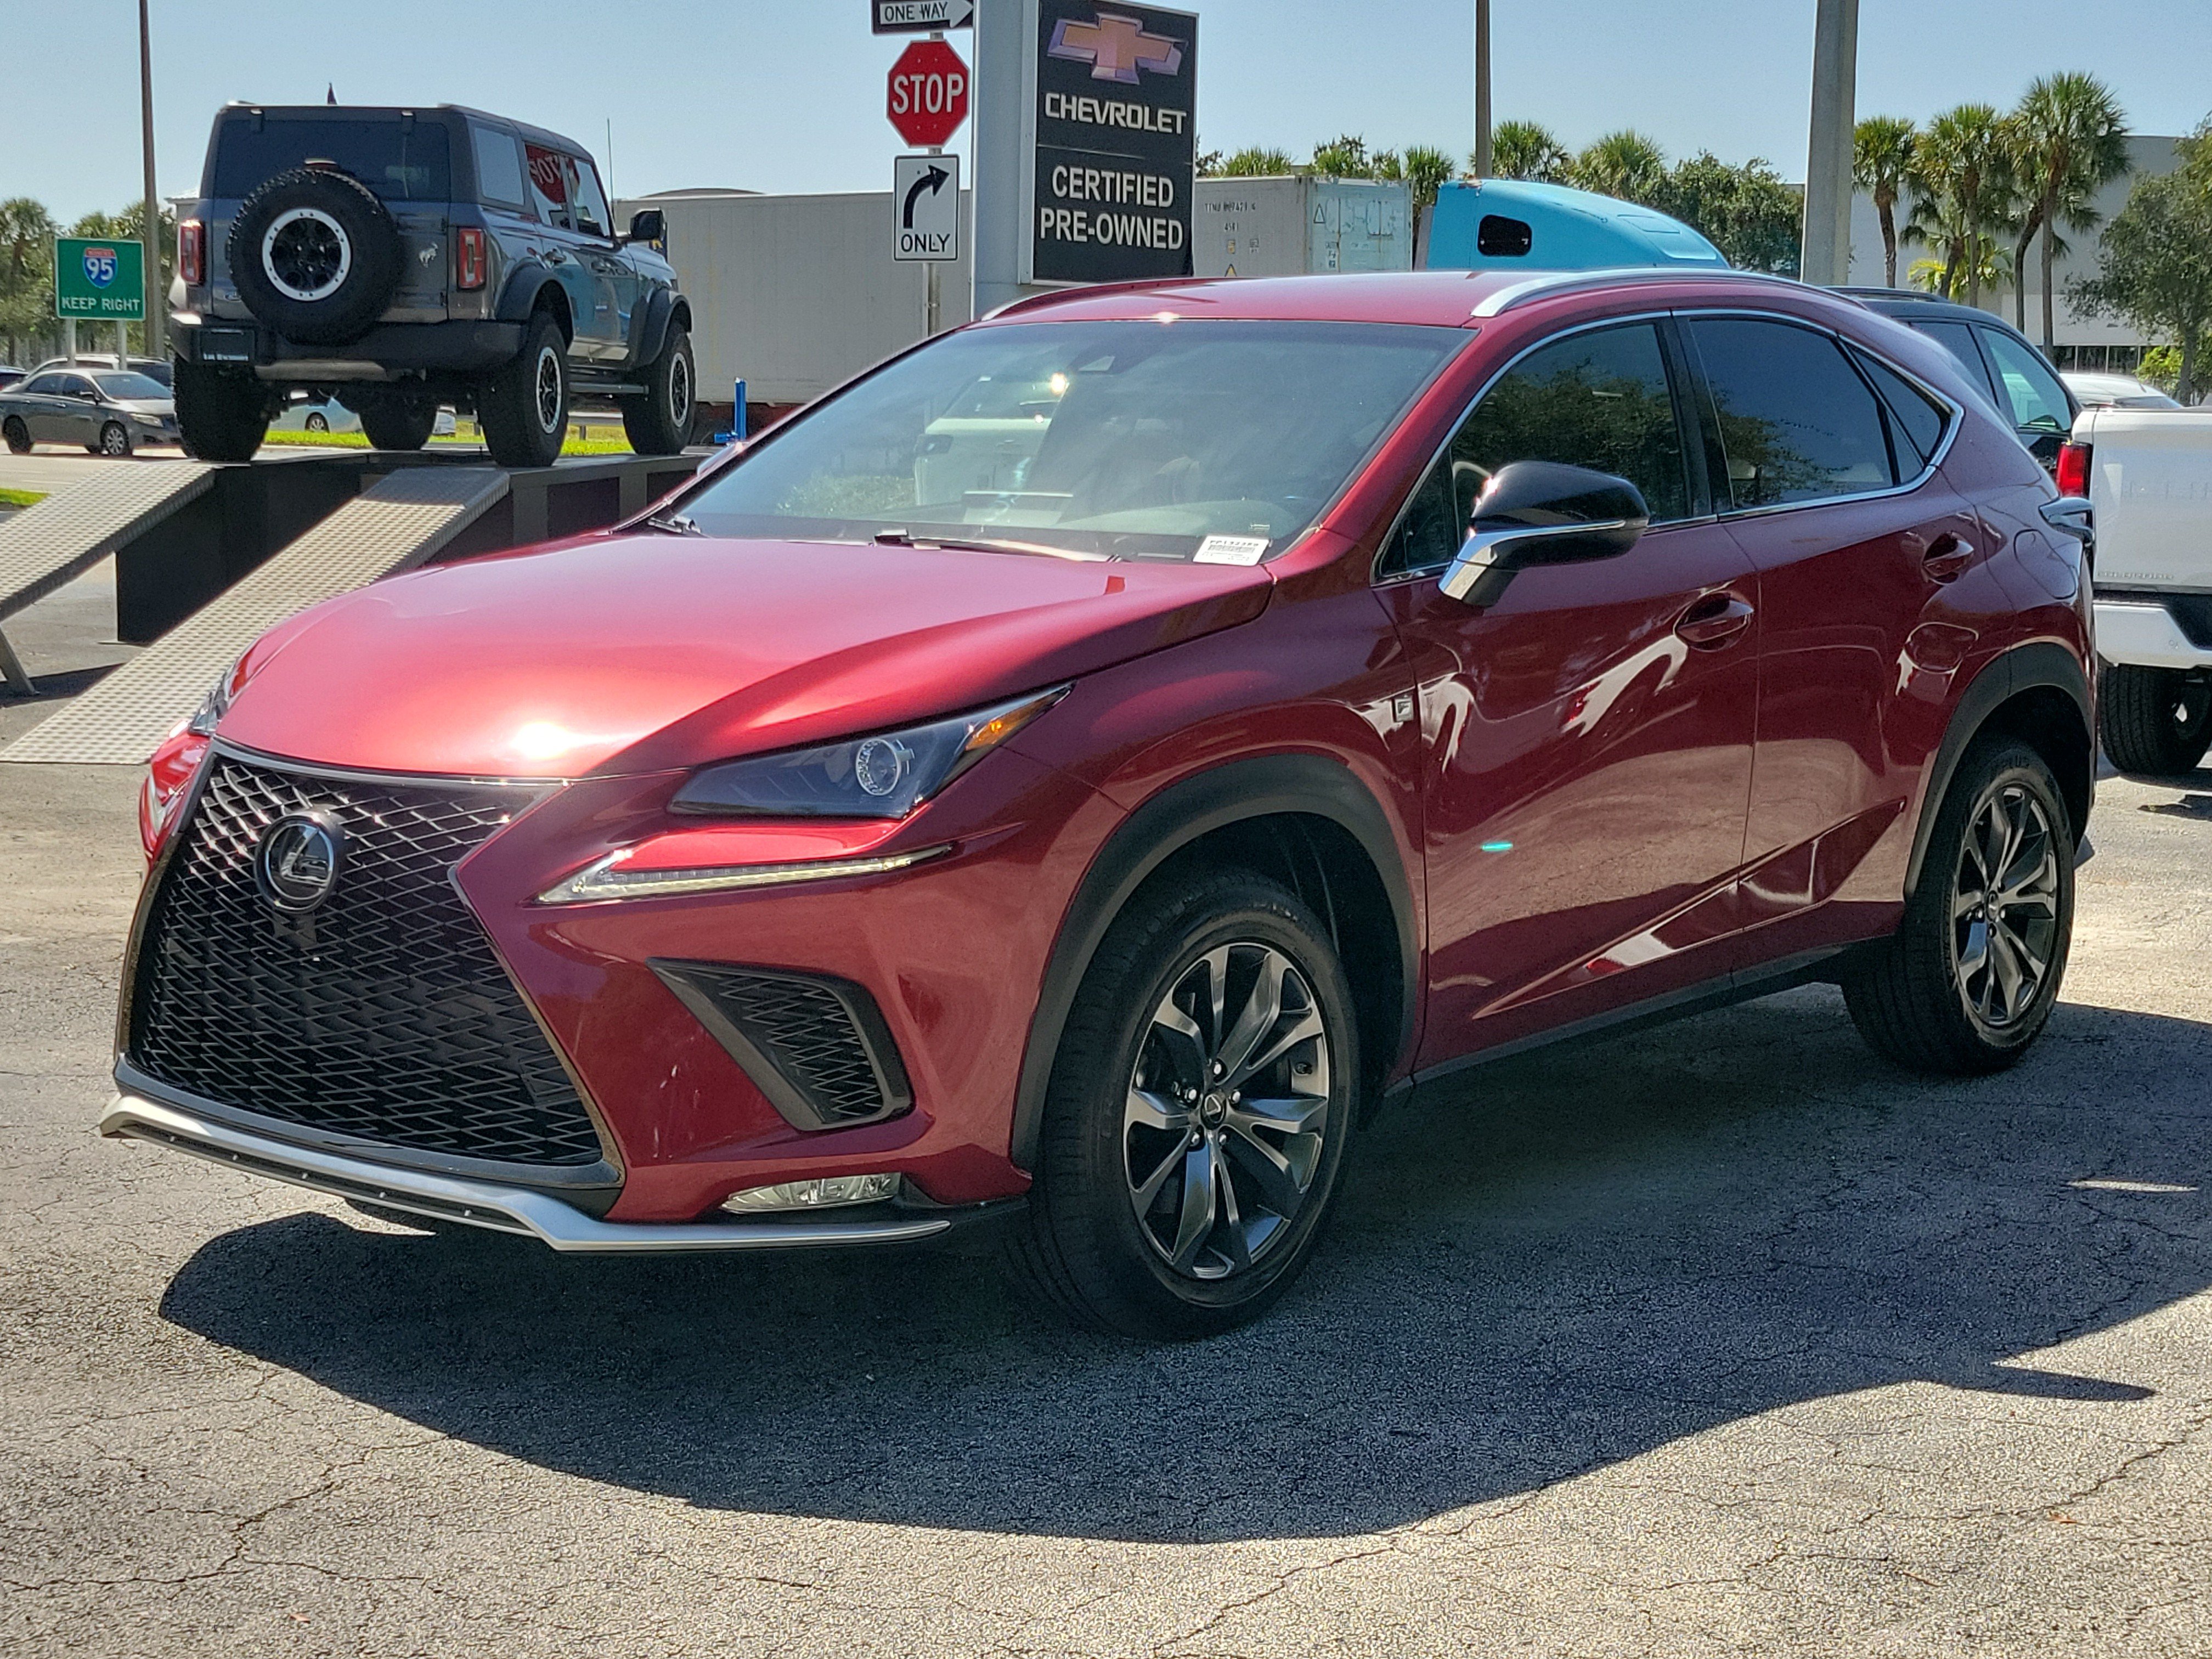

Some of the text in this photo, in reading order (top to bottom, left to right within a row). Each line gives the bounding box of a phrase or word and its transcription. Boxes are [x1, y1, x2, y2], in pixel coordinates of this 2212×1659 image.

[885, 2, 949, 21] ONE WAY
[893, 74, 963, 114] STOP
[1045, 93, 1187, 134] CHEVROLET
[1052, 166, 1174, 207] CERTIFIED
[900, 233, 950, 252] ONLY
[1041, 208, 1183, 250] PRE-OWNED
[86, 258, 114, 280] 95
[61, 297, 140, 311] KEEP RIGHT
